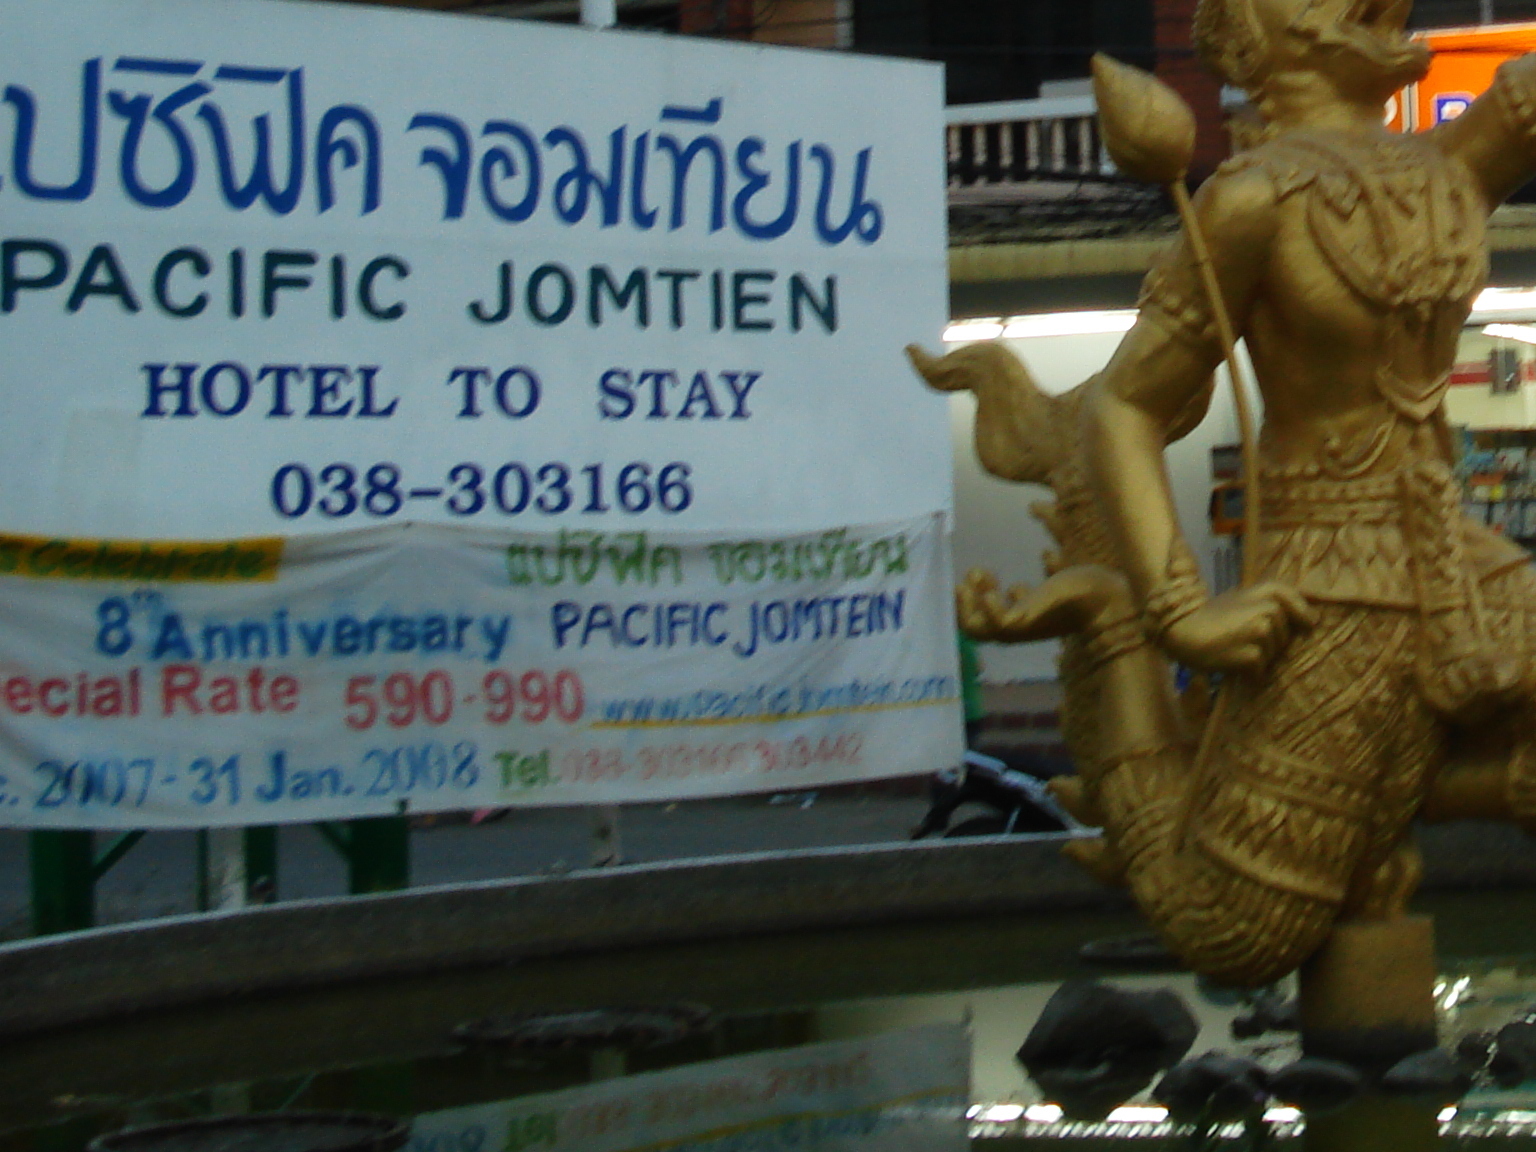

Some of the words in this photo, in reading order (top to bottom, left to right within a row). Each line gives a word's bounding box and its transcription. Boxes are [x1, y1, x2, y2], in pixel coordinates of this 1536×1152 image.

[0, 56, 384, 216] ปซิฟิค
[406, 96, 885, 248] จอมเทียน
[0, 238, 411, 322] PACIFIC
[468, 258, 840, 334] JOMTIEN
[142, 362, 399, 420] HOTEL
[448, 365, 541, 418] TO
[599, 367, 763, 421] STAY
[269, 460, 694, 519] 038-303166
[150, 606, 512, 663] Anniversary
[551, 599, 729, 649] PACIFIC
[3, 664, 142, 718] ecial
[161, 663, 301, 717] Rate
[255, 750, 355, 803] Jan.
[361, 739, 481, 798] 2008
